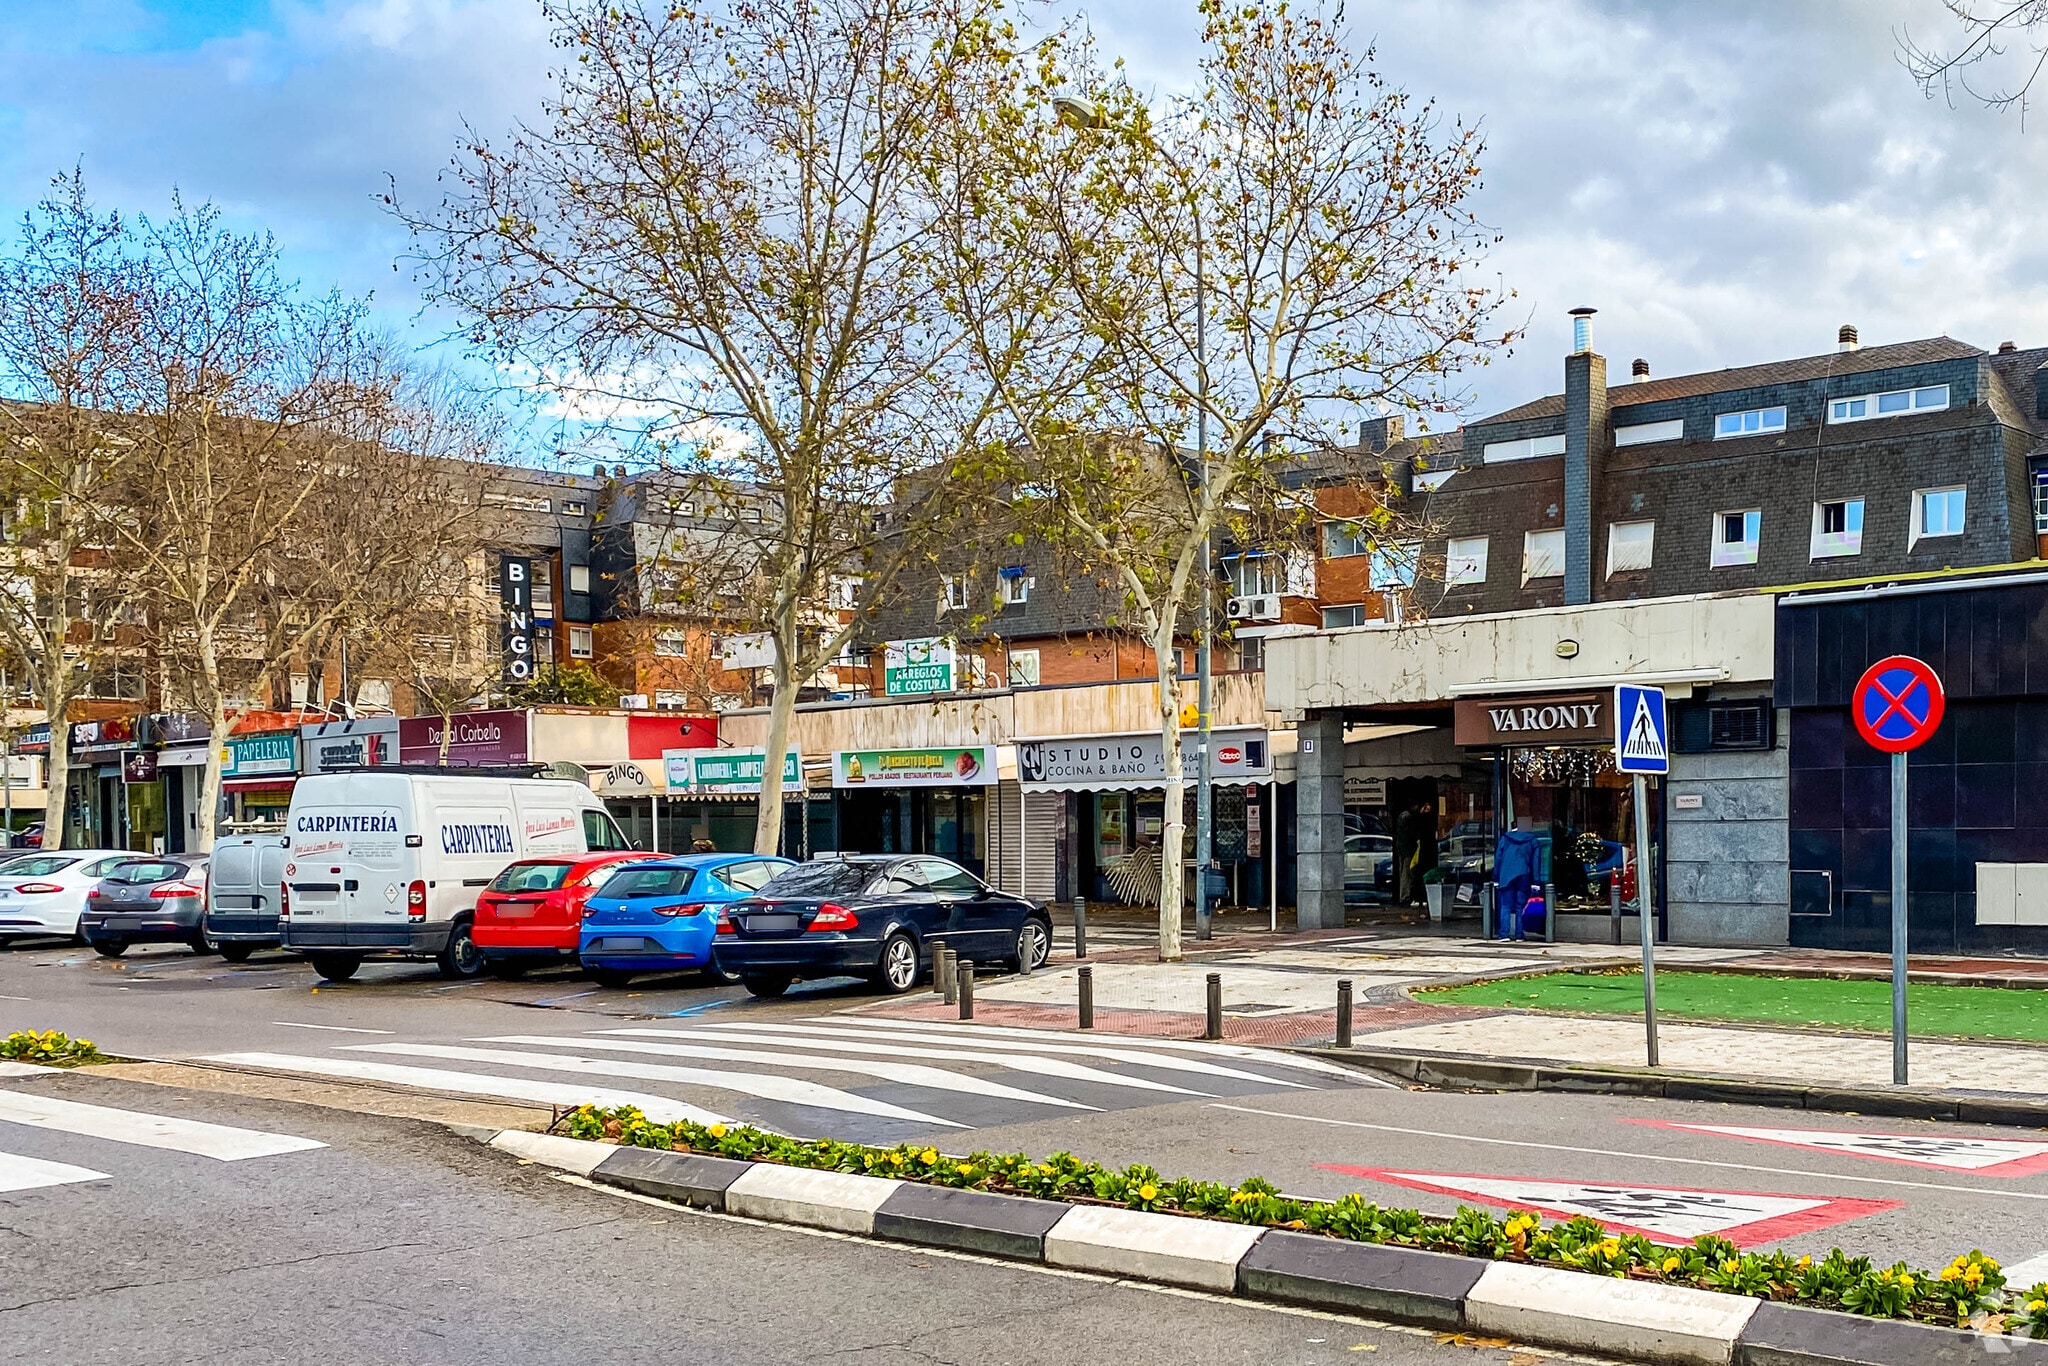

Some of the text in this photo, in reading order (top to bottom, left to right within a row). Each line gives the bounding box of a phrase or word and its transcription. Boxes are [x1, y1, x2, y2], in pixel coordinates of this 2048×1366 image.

[508, 562, 529, 678] BINGO
[895, 666, 943, 680] ARREGLOS
[889, 678, 948, 693] DE COSTURA
[1488, 703, 1601, 732] VARONY
[428, 722, 501, 744] Deal Corbella
[237, 740, 290, 761] PAPELERIA
[1048, 745, 1143, 762] STUDIO
[606, 763, 645, 785] BINGO
[1047, 761, 1146, 776] COCINA & BAÑO
[297, 810, 398, 832] CARPINTERÍA
